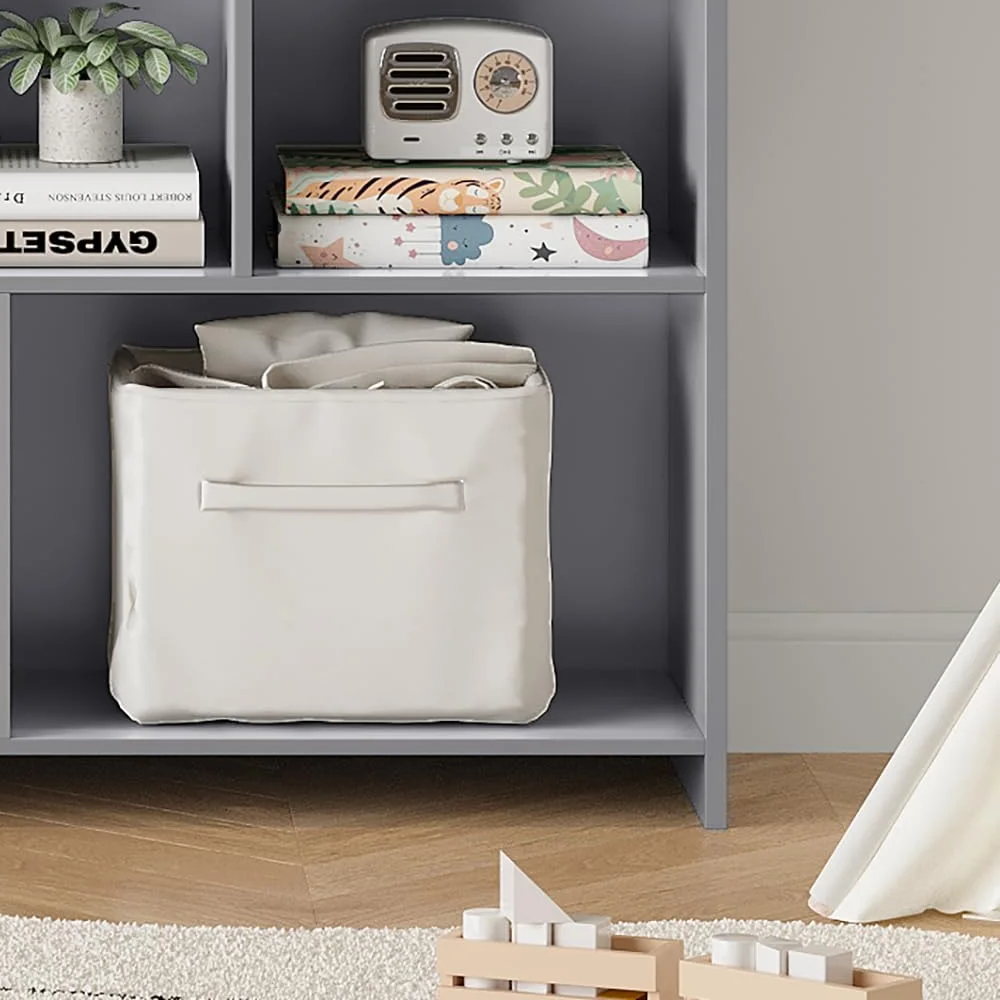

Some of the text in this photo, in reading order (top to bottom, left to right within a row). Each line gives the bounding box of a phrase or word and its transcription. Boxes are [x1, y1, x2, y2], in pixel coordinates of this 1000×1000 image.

[48, 192, 193, 202] ROBERT LOUIS STEVENSON
